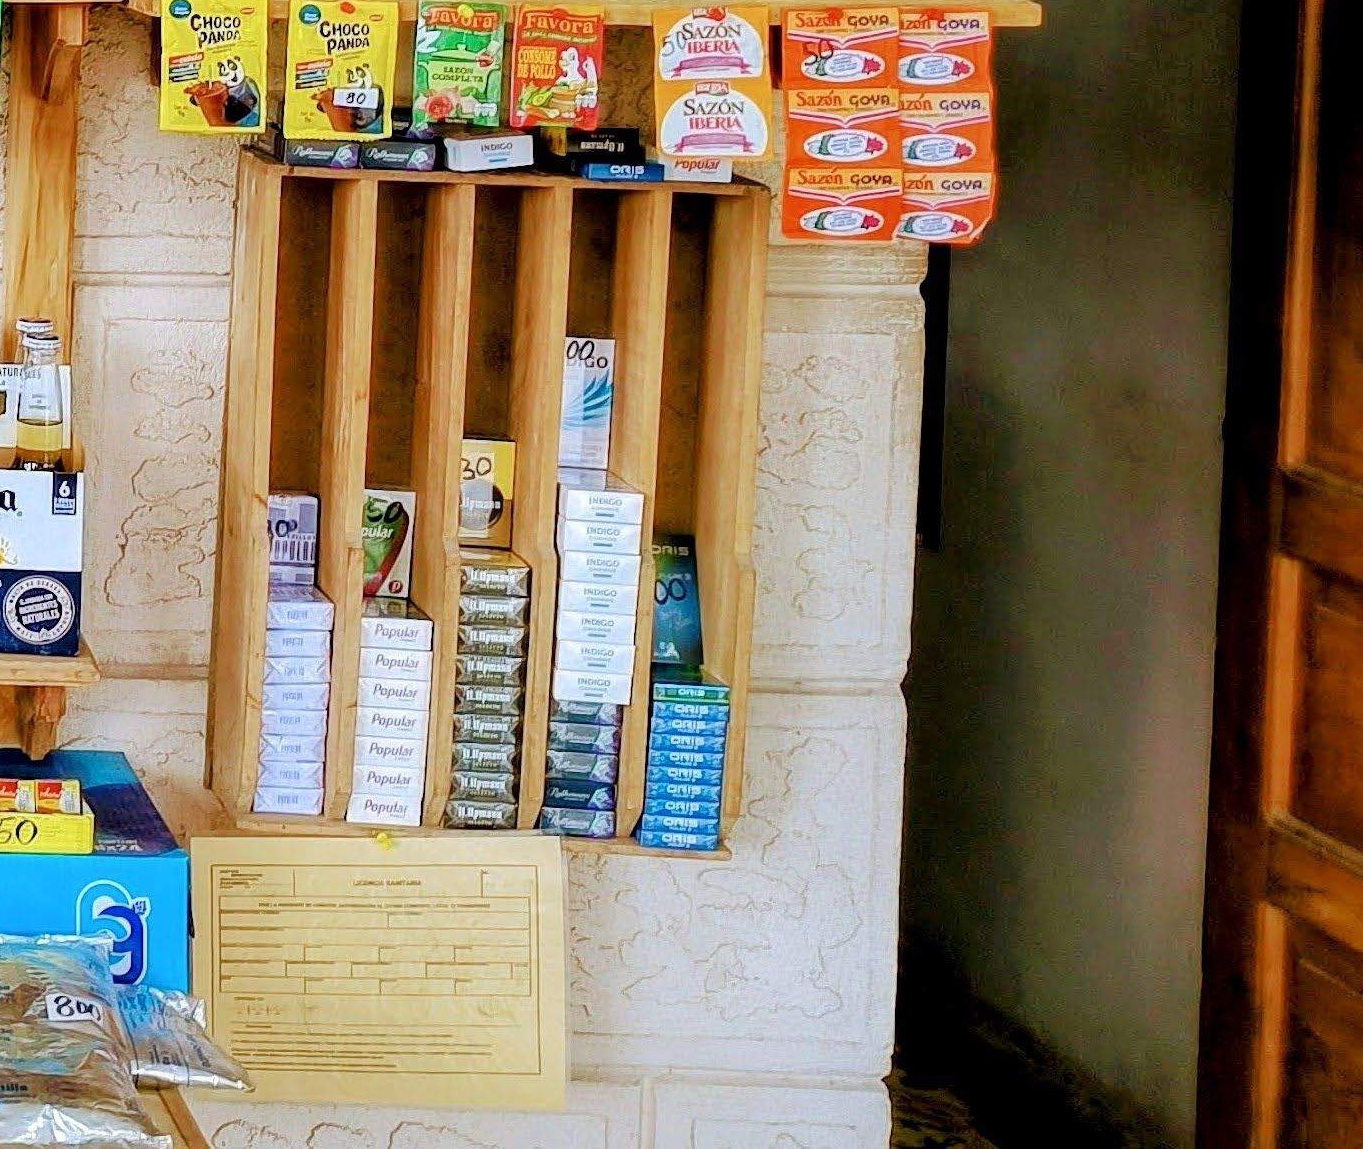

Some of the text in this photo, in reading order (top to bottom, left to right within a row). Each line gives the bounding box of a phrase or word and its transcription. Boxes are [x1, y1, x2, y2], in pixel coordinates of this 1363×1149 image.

[190, 14, 241, 32] CHOCO
[319, 21, 370, 38] CHOCO
[682, 22, 742, 40] SAZÓN
[937, 18, 980, 30] GOYA
[326, 36, 370, 54] PANDA
[687, 40, 740, 53] IBERIA
[345, 91, 367, 105] 80
[797, 91, 891, 107] Sazón GOYA
[683, 97, 745, 116] SAZÓN
[688, 117, 743, 129] IBERIA
[480, 141, 514, 152] INDIGO
[797, 169, 893, 186] Sazón GOYA
[941, 178, 983, 190] GOYA
[58, 480, 70, 498] 6
[589, 496, 623, 508] INDIGO
[586, 526, 621, 537] INDIGO
[374, 625, 420, 642] Popular
[374, 654, 420, 670] Popular
[577, 677, 611, 689] INDIGO
[373, 684, 419, 699] Popular
[371, 713, 417, 730] Popular
